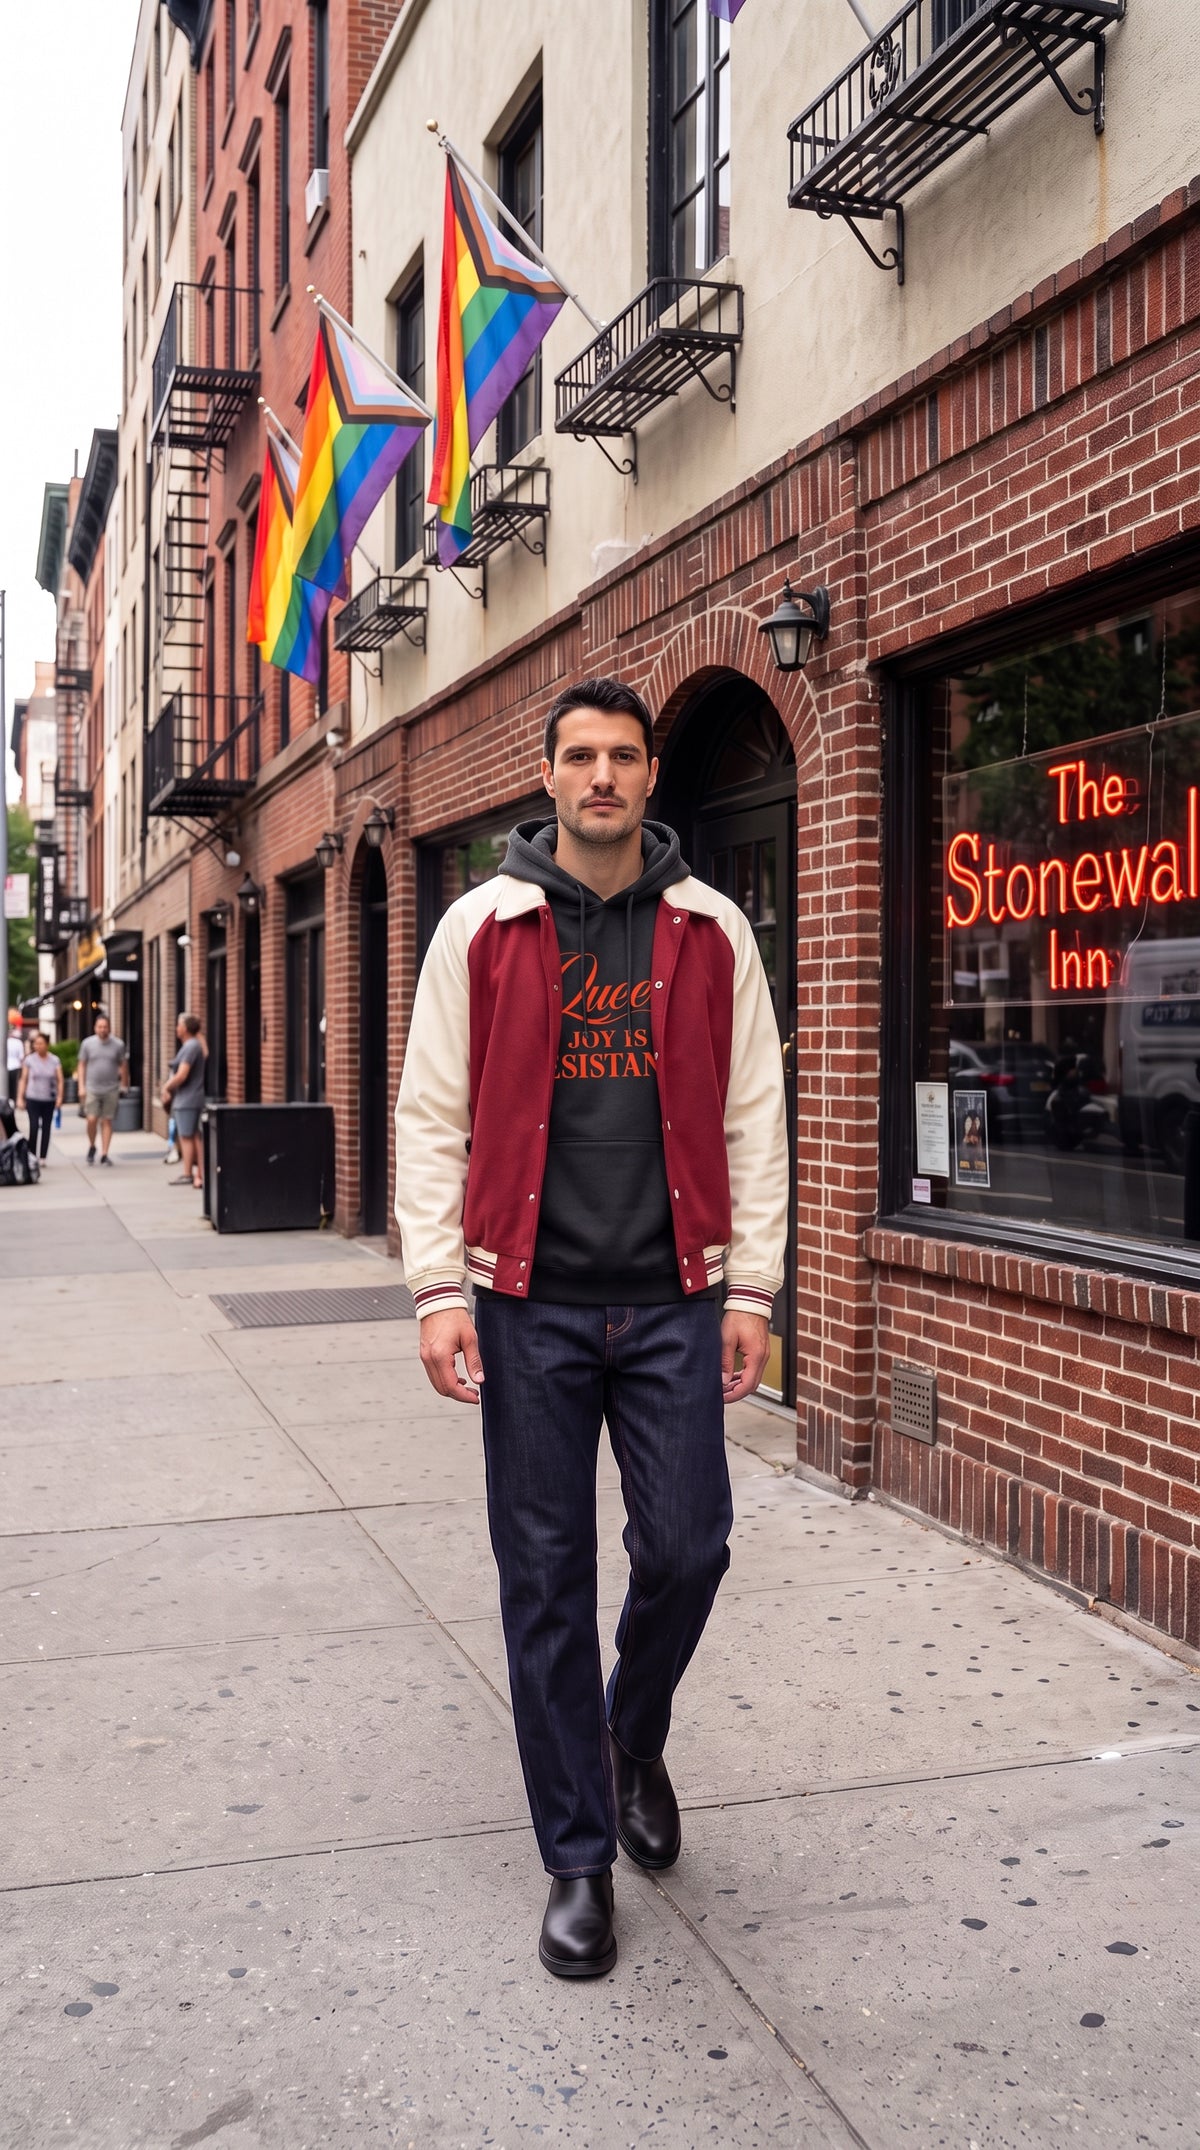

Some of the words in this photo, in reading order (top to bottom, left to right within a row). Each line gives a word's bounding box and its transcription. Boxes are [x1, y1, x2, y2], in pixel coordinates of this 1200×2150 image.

[1047, 759, 1125, 824] The
[1049, 929, 1111, 990] Inn
[568, 1029, 616, 1049] JOY
[624, 1028, 648, 1048] IS
